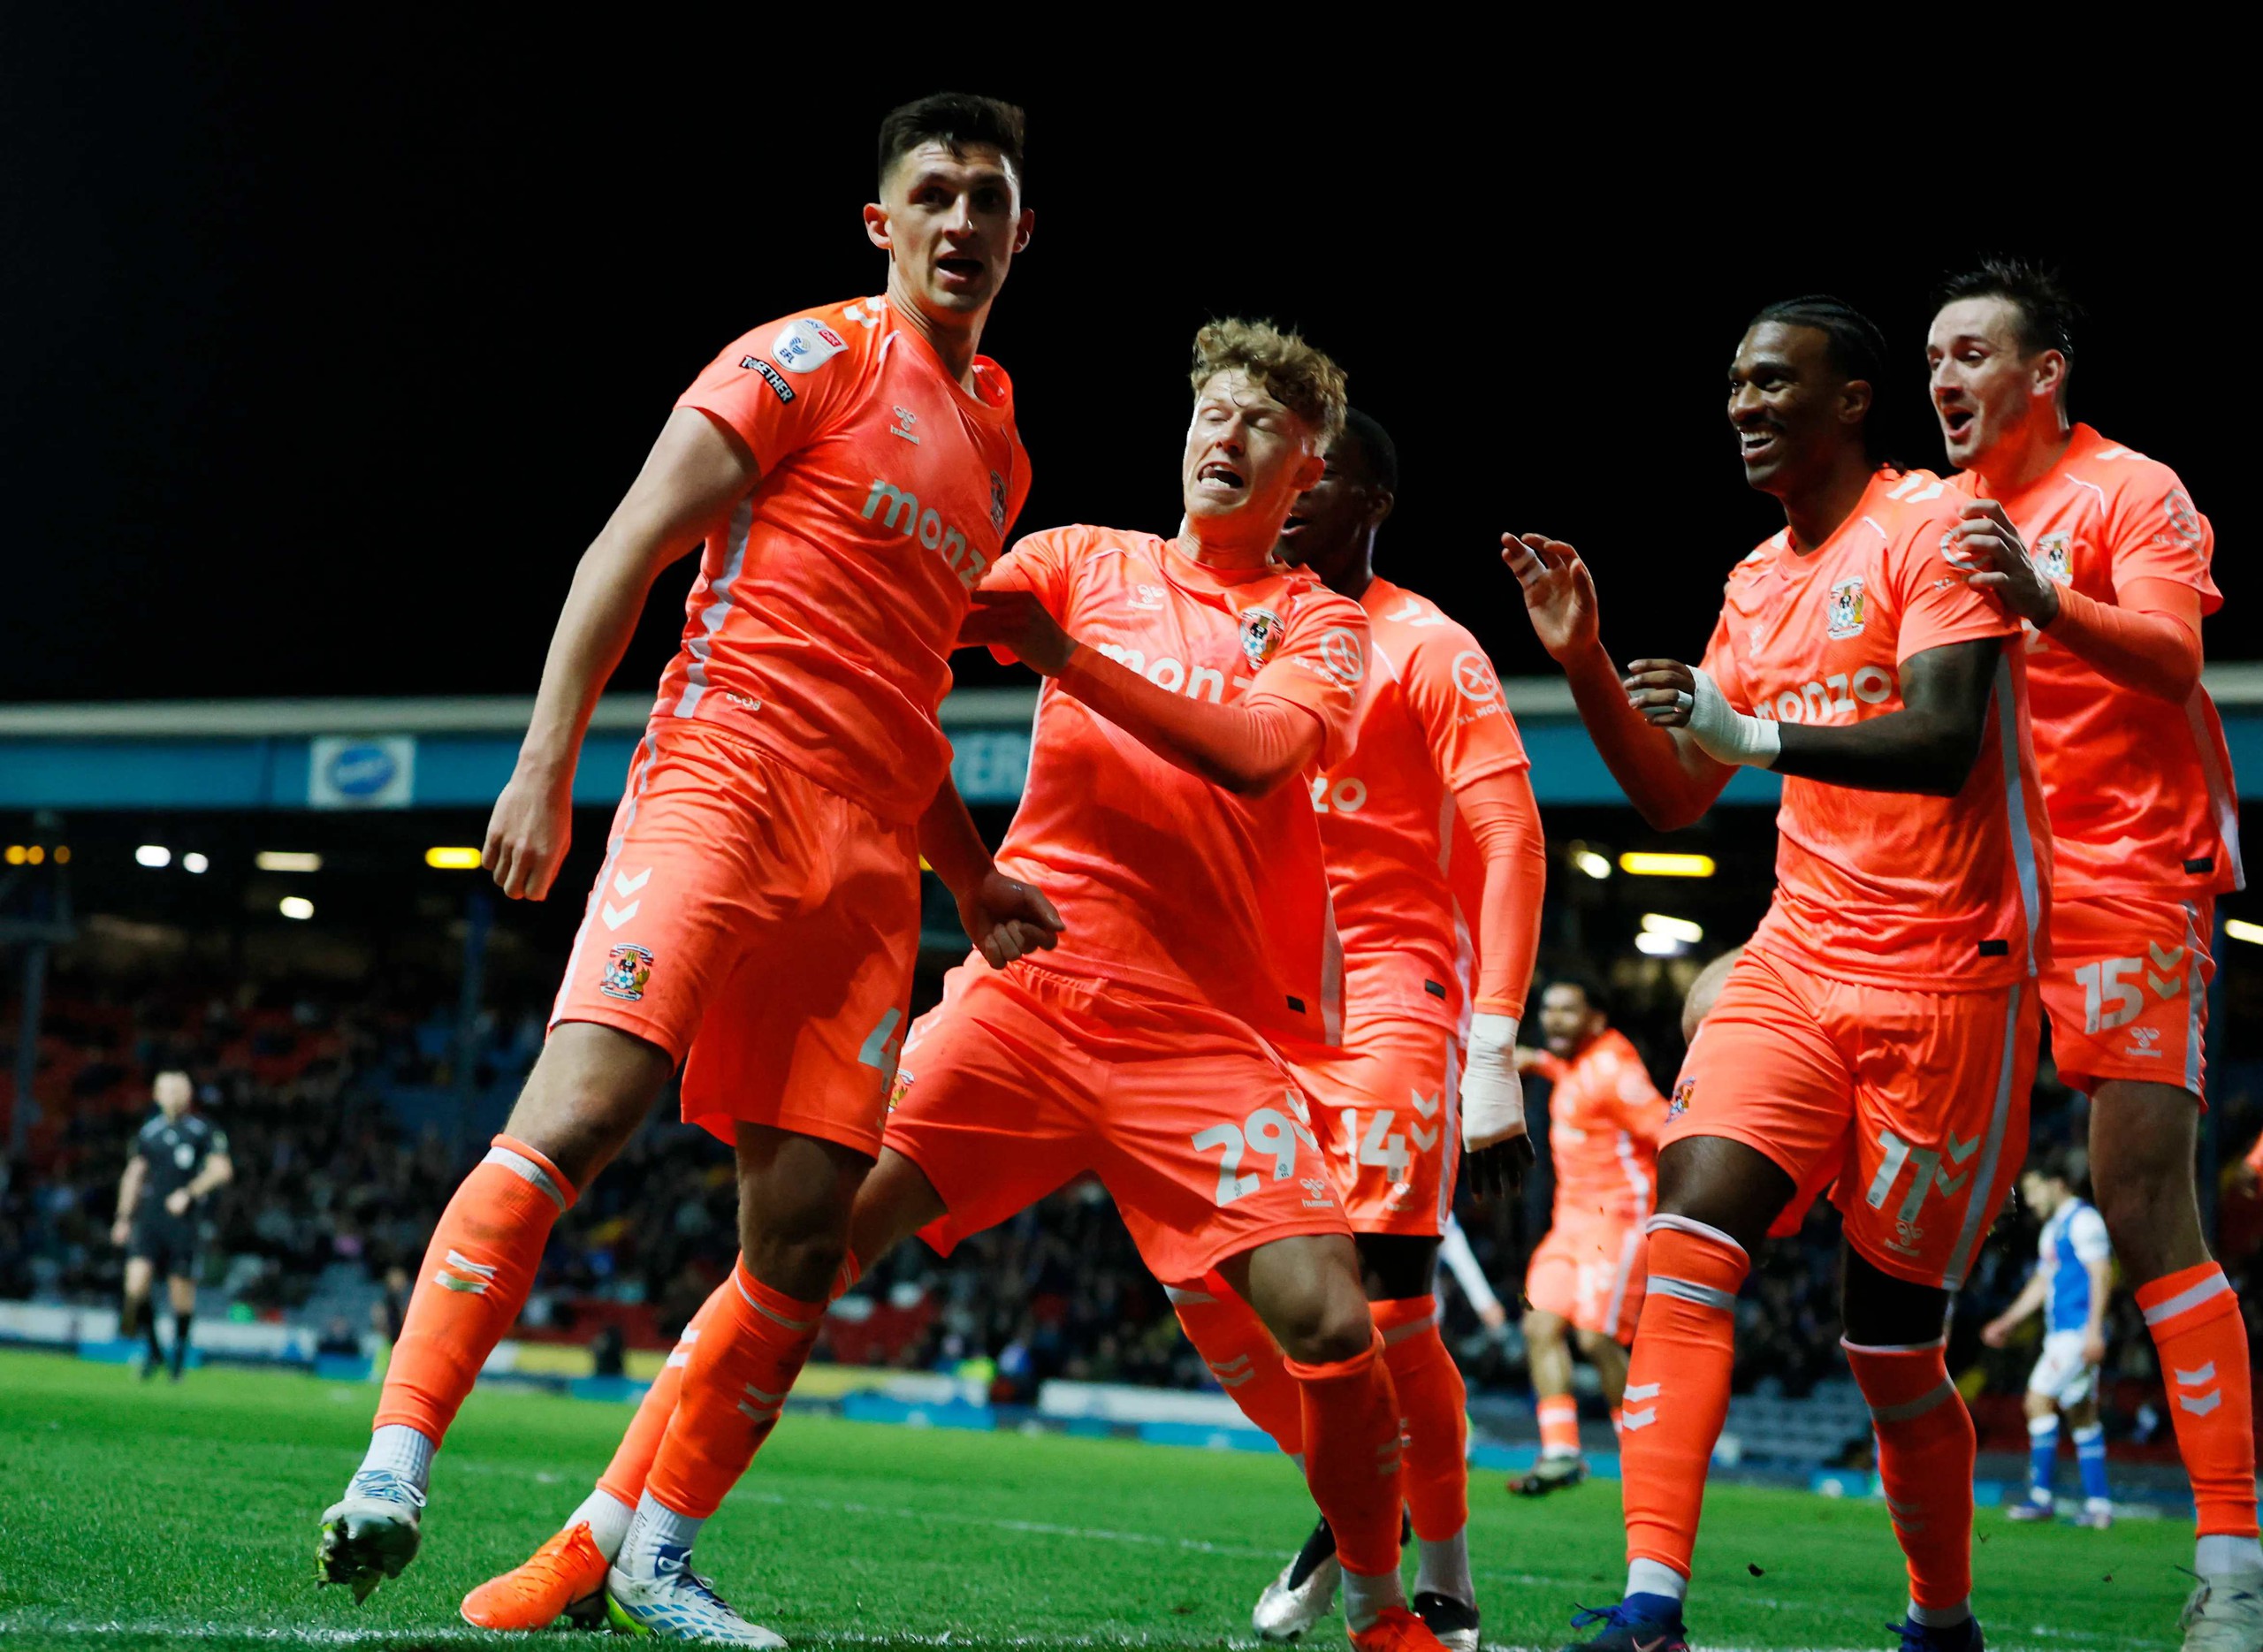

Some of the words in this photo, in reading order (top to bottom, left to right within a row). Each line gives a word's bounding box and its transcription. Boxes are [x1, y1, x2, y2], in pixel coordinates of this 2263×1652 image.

[779, 347, 796, 364] EFL
[861, 478, 989, 589] monz
[1098, 643, 1253, 704] mon
[2074, 957, 2144, 1035] 15
[857, 1007, 902, 1094] 4
[1191, 1108, 1296, 1208] 29
[1340, 1108, 1410, 1183] 14
[1865, 1129, 1942, 1224] 11
